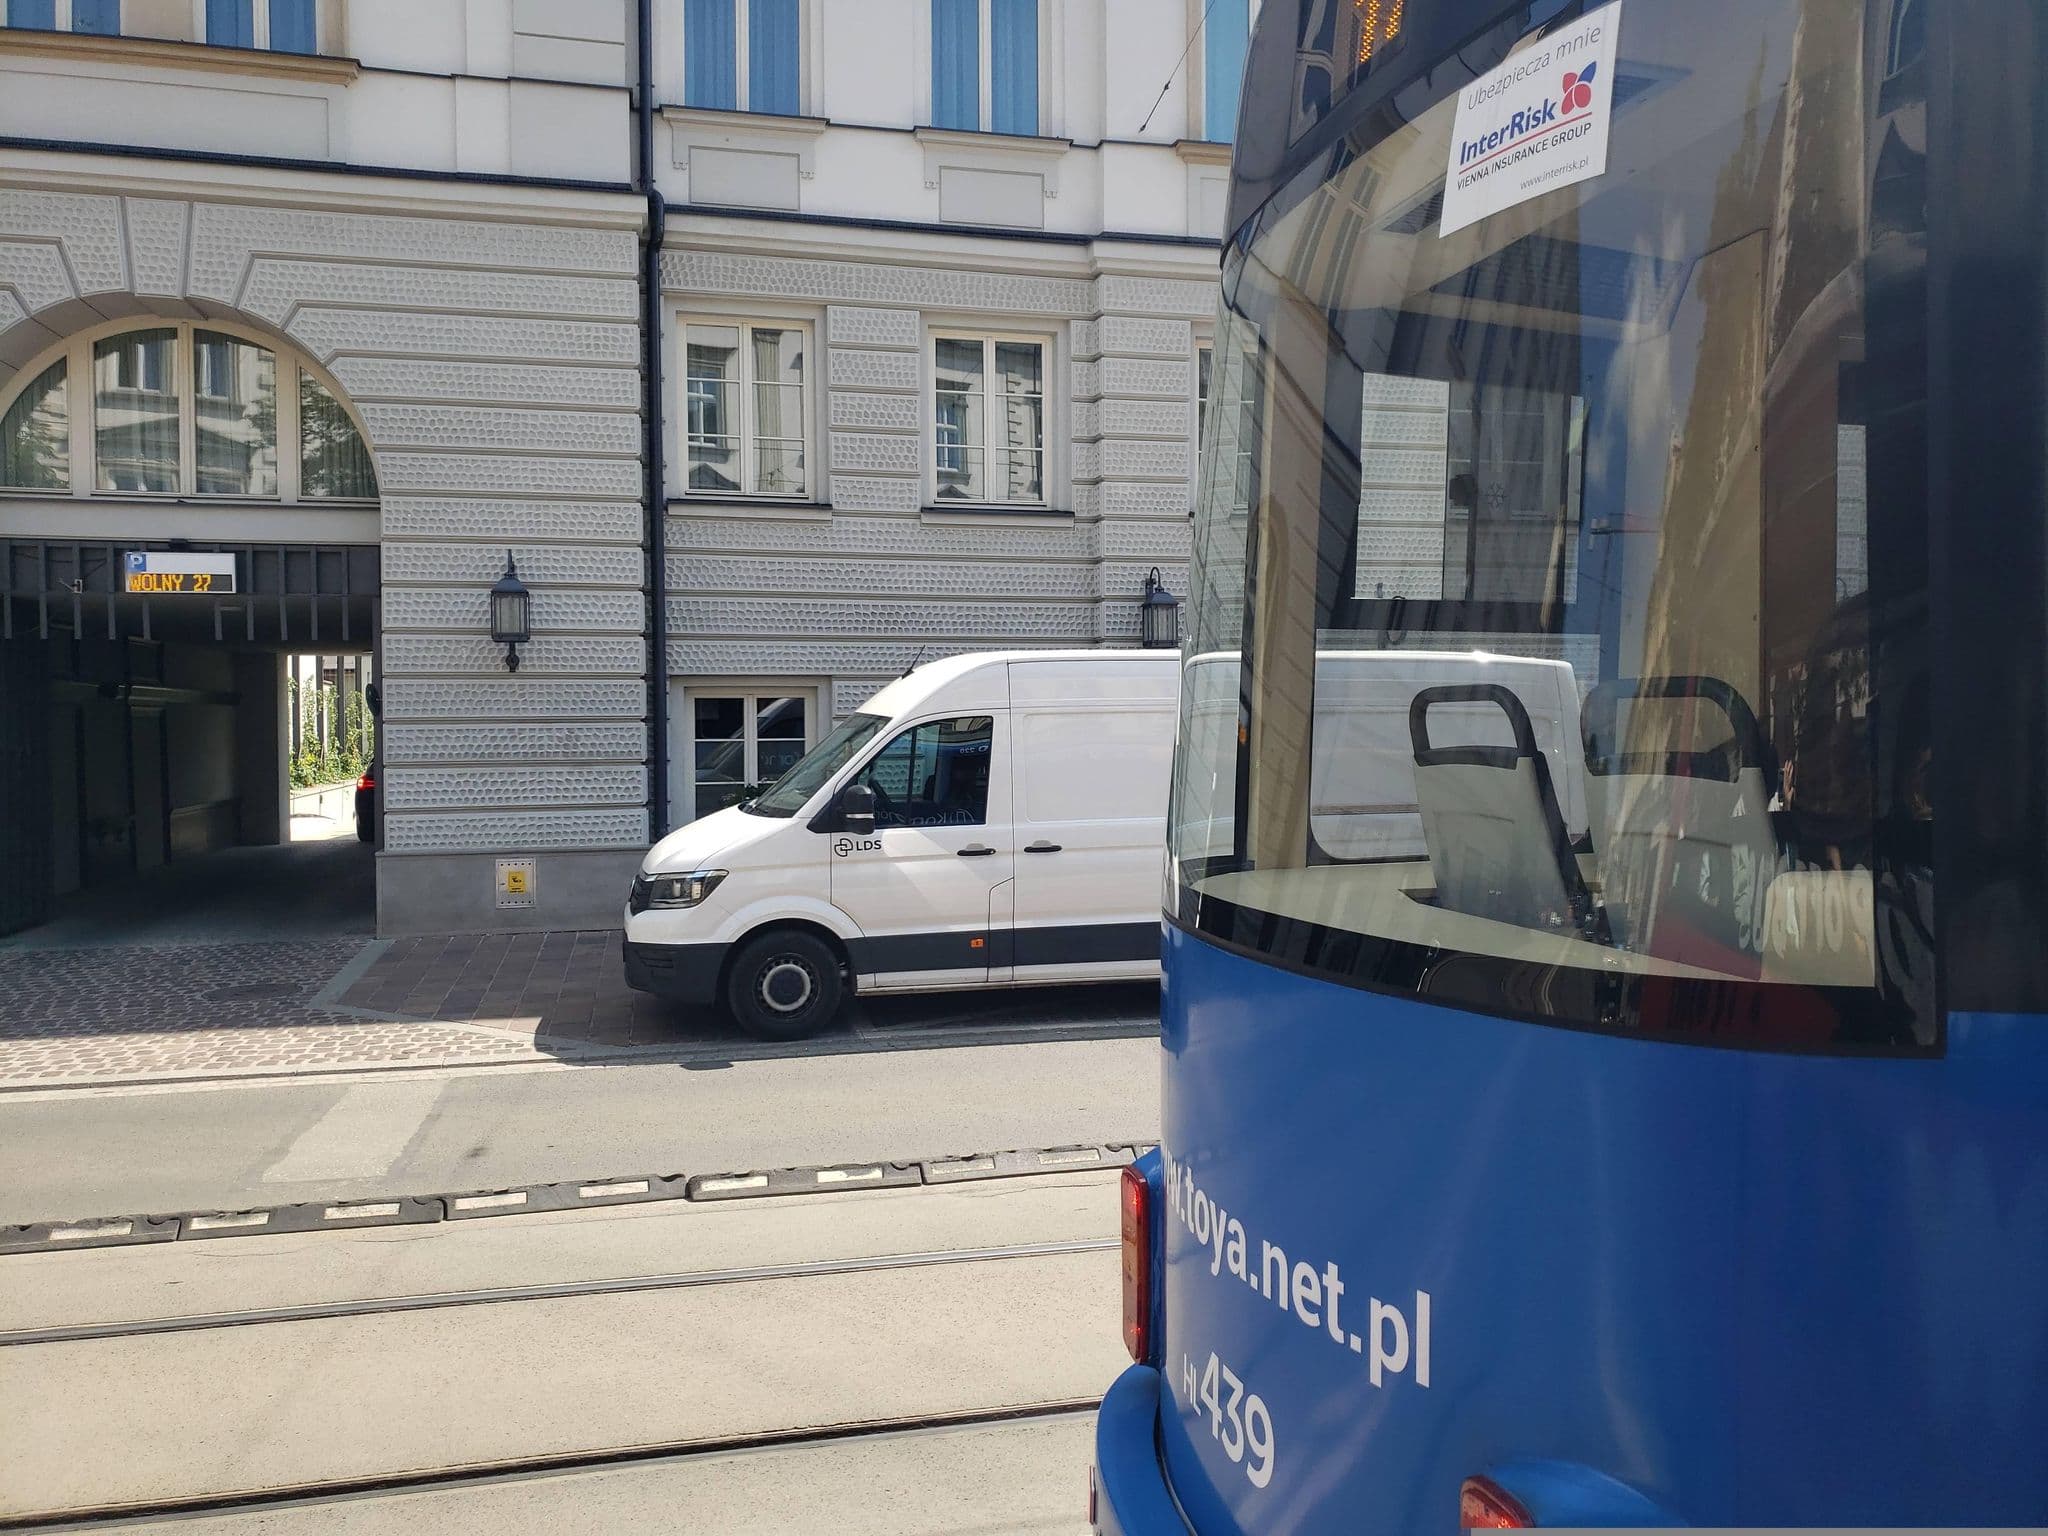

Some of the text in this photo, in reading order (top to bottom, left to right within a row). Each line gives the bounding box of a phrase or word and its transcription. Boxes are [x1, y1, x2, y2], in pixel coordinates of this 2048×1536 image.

[1467, 25, 1601, 111] Ubezpiecza mnie
[1457, 122, 1592, 191] VIENNA INSURANCE GROUP
[1459, 98, 1558, 166] InterRisk
[1519, 156, 1589, 190] www.interrisk.pl
[128, 574, 211, 592] WOLNY 27
[130, 554, 143, 568] P
[856, 840, 882, 851] LDS
[1166, 1150, 1431, 1388] w.toya.net.pl
